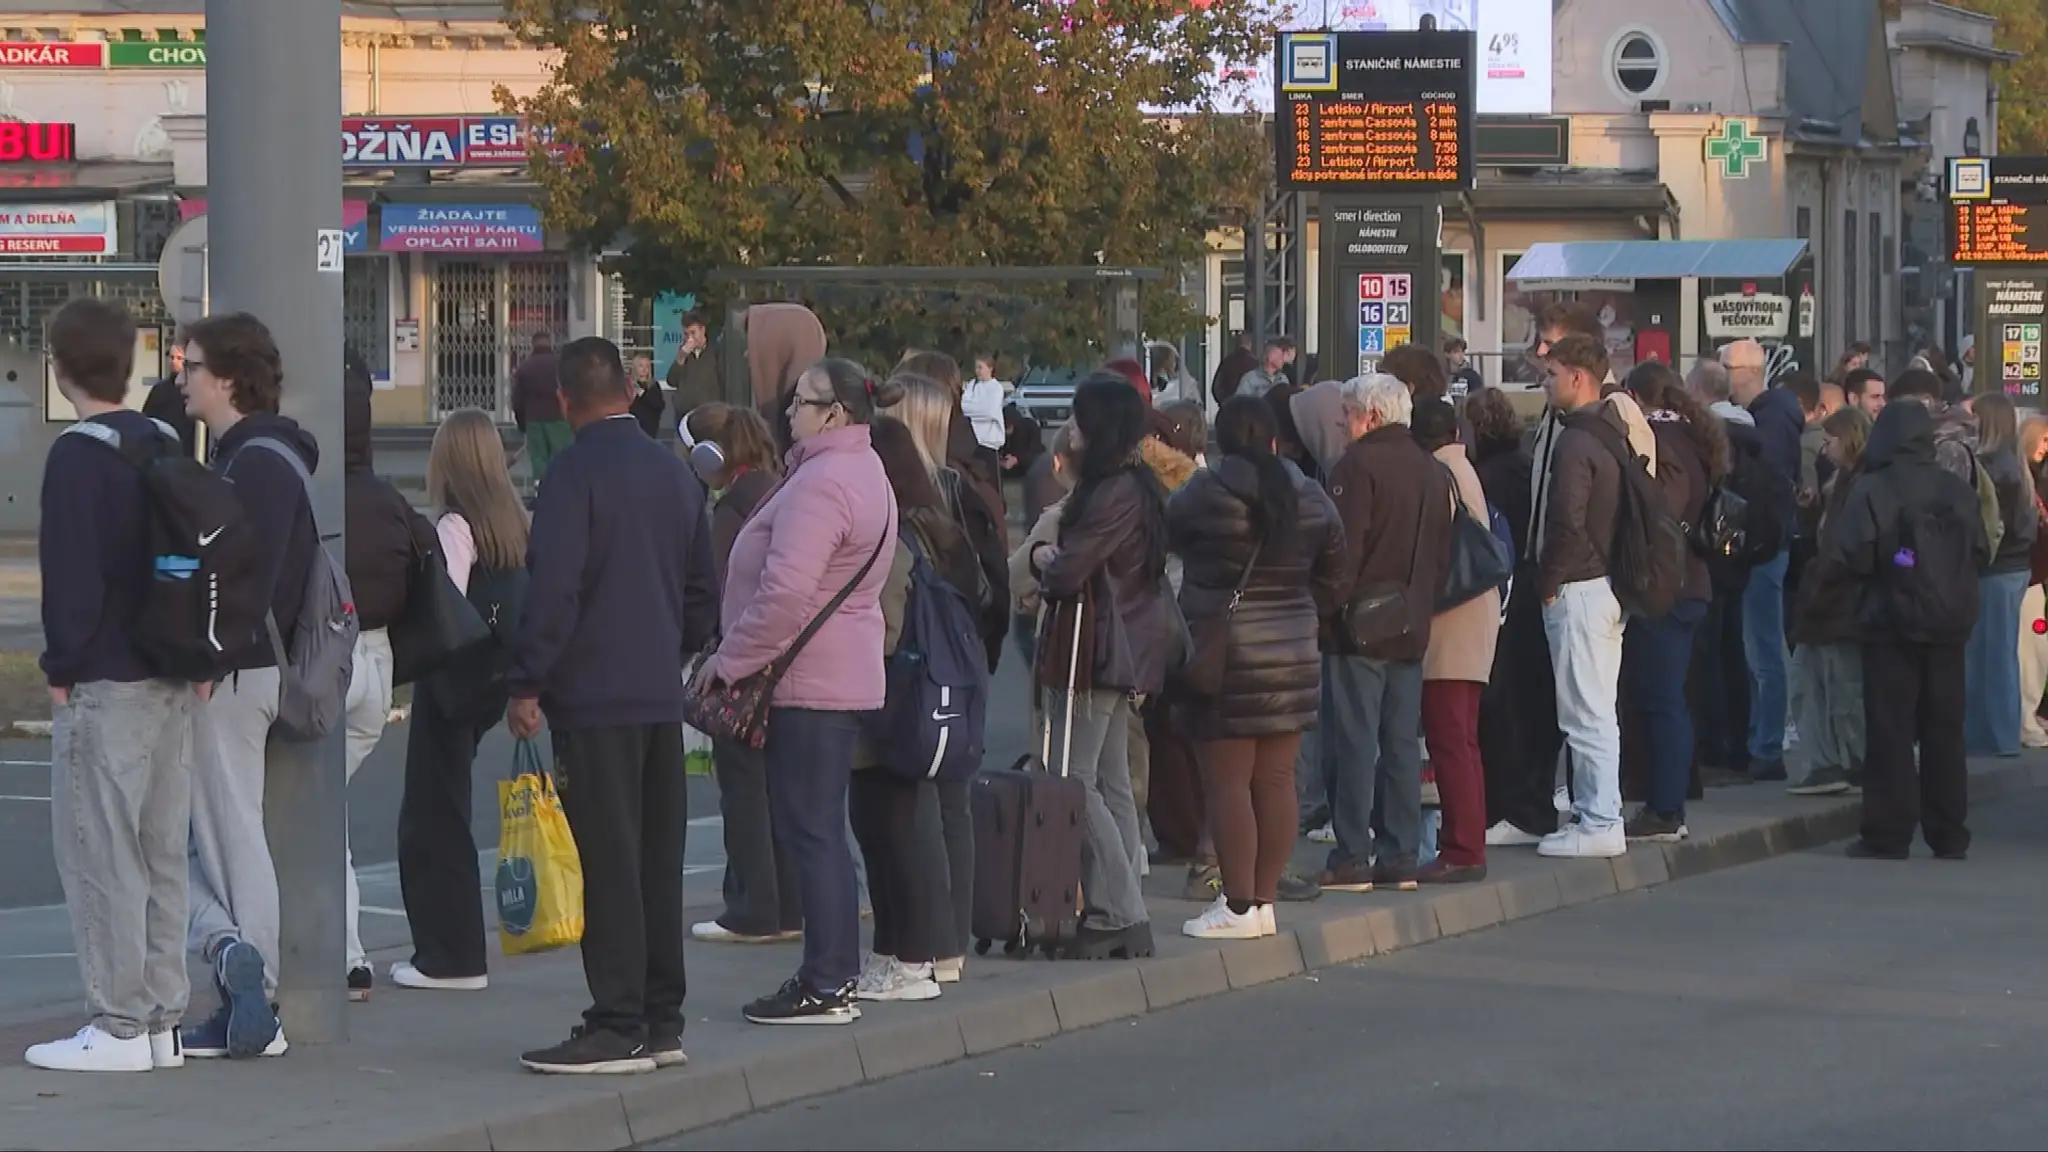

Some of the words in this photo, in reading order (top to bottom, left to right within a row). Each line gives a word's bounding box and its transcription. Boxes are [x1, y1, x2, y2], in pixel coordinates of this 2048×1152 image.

[1346, 57, 1401, 69] STANIČNÉ
[1404, 57, 1461, 69] NÁMESTIE
[1295, 104, 1309, 115] 23
[1320, 104, 1362, 115] Letisko
[1371, 104, 1413, 115] Airport
[1439, 104, 1456, 114] min
[1365, 117, 1417, 128] Cassovia
[1430, 117, 1437, 127] 2
[1439, 117, 1457, 127] min
[1365, 130, 1417, 141] Cassovia
[1430, 130, 1437, 140] 8
[1440, 130, 1457, 140] min
[1366, 143, 1417, 154] Cassovia
[1435, 142, 1457, 153] 7:50
[1297, 156, 1310, 167] 23
[1322, 156, 1363, 167] Letisko
[1373, 156, 1415, 167] Airport
[1435, 155, 1458, 166] 7:58
[27, 211, 76, 224] DIELŇA
[417, 208, 507, 220] ŽIADAJTE
[1334, 212, 1357, 221] smer
[1363, 210, 1401, 222] direction
[388, 224, 480, 233] VERNOSTNÚ
[485, 225, 536, 233] KARTU
[1359, 226, 1397, 238] NÁMESTIE
[7, 239, 60, 251] RESERVE
[405, 235, 469, 248] OPLATÍ
[1362, 280, 1381, 296] 10
[1389, 279, 1407, 296] 15
[1996, 287, 2043, 301] NÁMESTIE
[1713, 299, 1783, 313] MÄSOVÝROBA
[1362, 306, 1381, 322] 16
[1389, 305, 1407, 322] 21
[1721, 313, 1774, 326] PEČOVSKÁ
[2006, 328, 2020, 339] 17
[2024, 328, 2038, 339] 19
[2024, 345, 2038, 358] 57
[2005, 364, 2020, 377] N2
[2024, 364, 2038, 377] N3
[2022, 381, 2039, 395] N6
